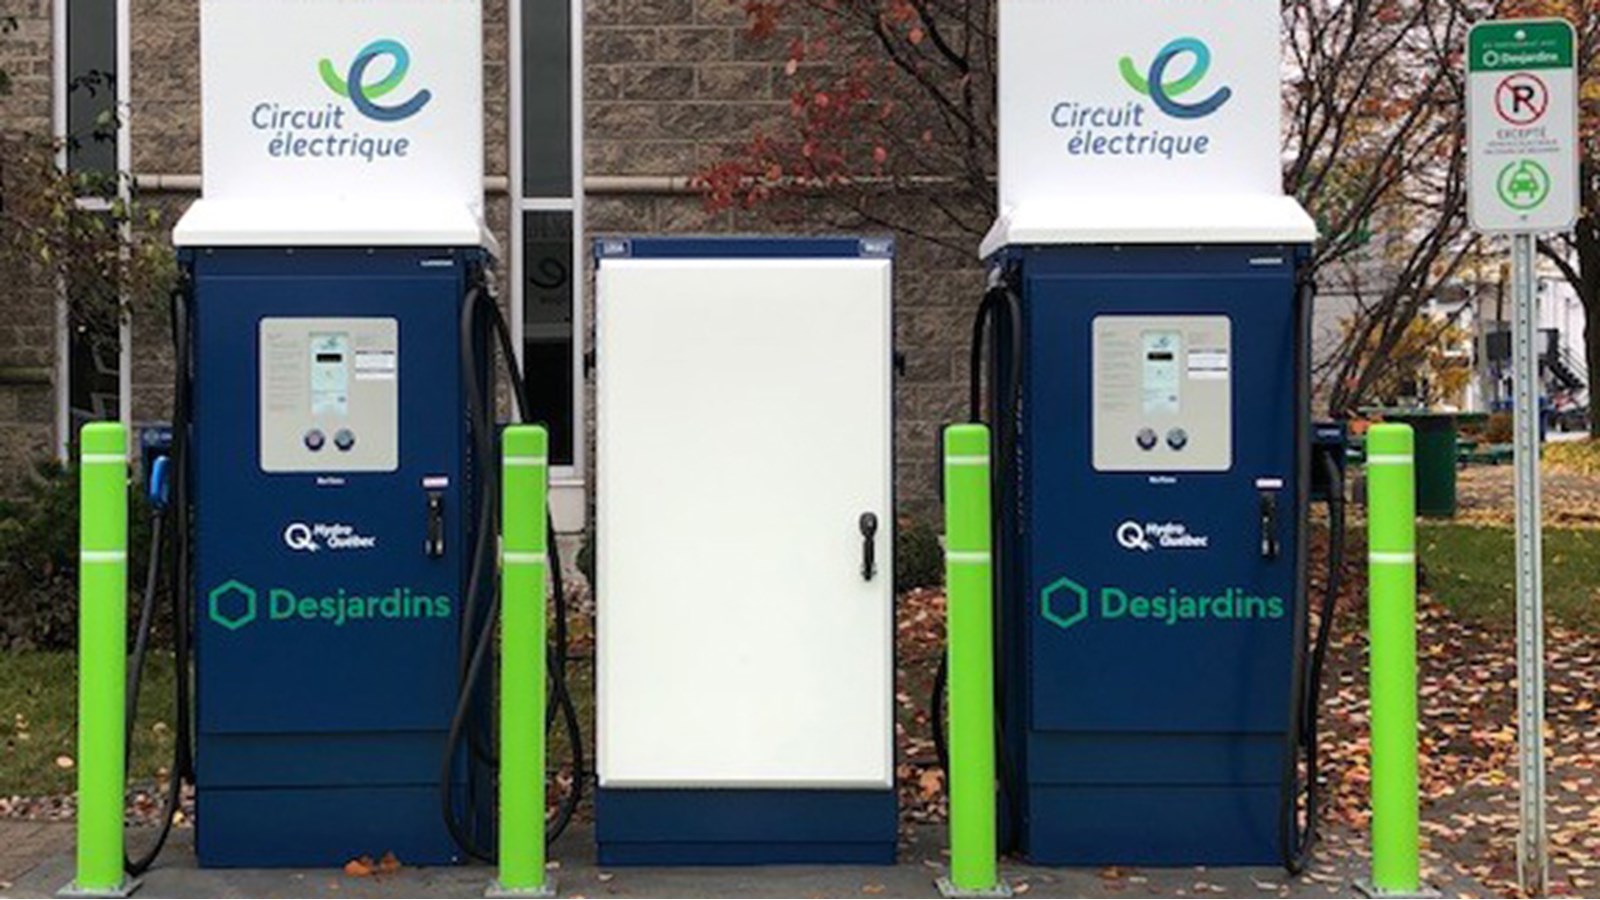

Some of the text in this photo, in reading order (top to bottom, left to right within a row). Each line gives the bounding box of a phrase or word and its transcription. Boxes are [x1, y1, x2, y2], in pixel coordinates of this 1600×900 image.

[1501, 50, 1559, 65] Desjardins
[251, 102, 345, 129] Circuit
[1051, 101, 1144, 127] Circuit
[268, 131, 409, 163] électrique
[1067, 130, 1209, 160] électrique
[313, 523, 353, 538] Hydro
[1145, 522, 1185, 537] Hydro
[269, 587, 452, 626] Desjardins
[1101, 587, 1285, 625] Desjardins
